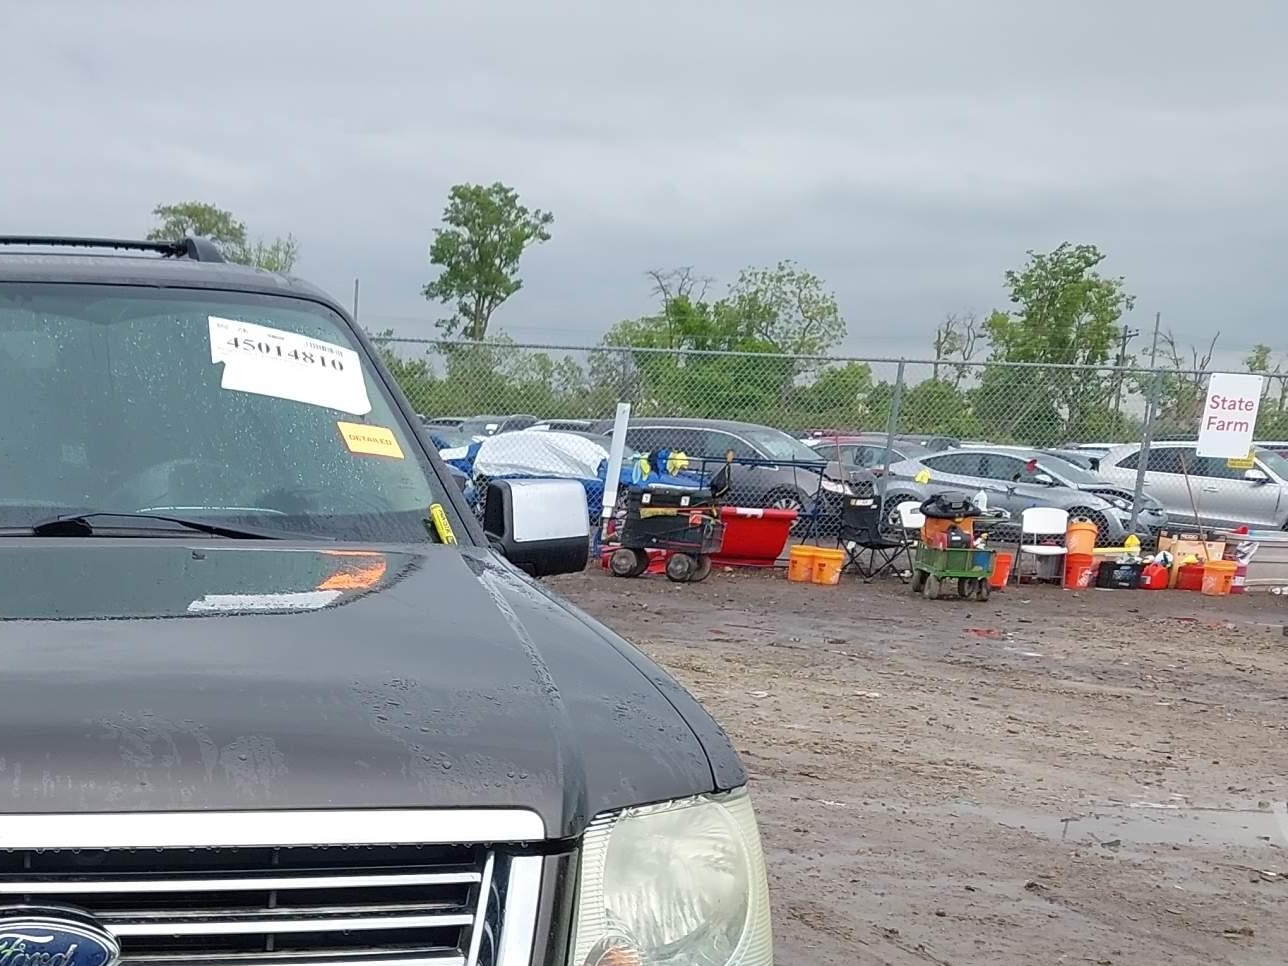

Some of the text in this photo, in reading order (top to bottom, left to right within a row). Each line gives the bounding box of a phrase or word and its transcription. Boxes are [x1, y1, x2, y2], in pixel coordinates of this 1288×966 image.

[226, 336, 344, 372] 45014810
[1209, 394, 1255, 412] State
[1207, 416, 1249, 432] Farm
